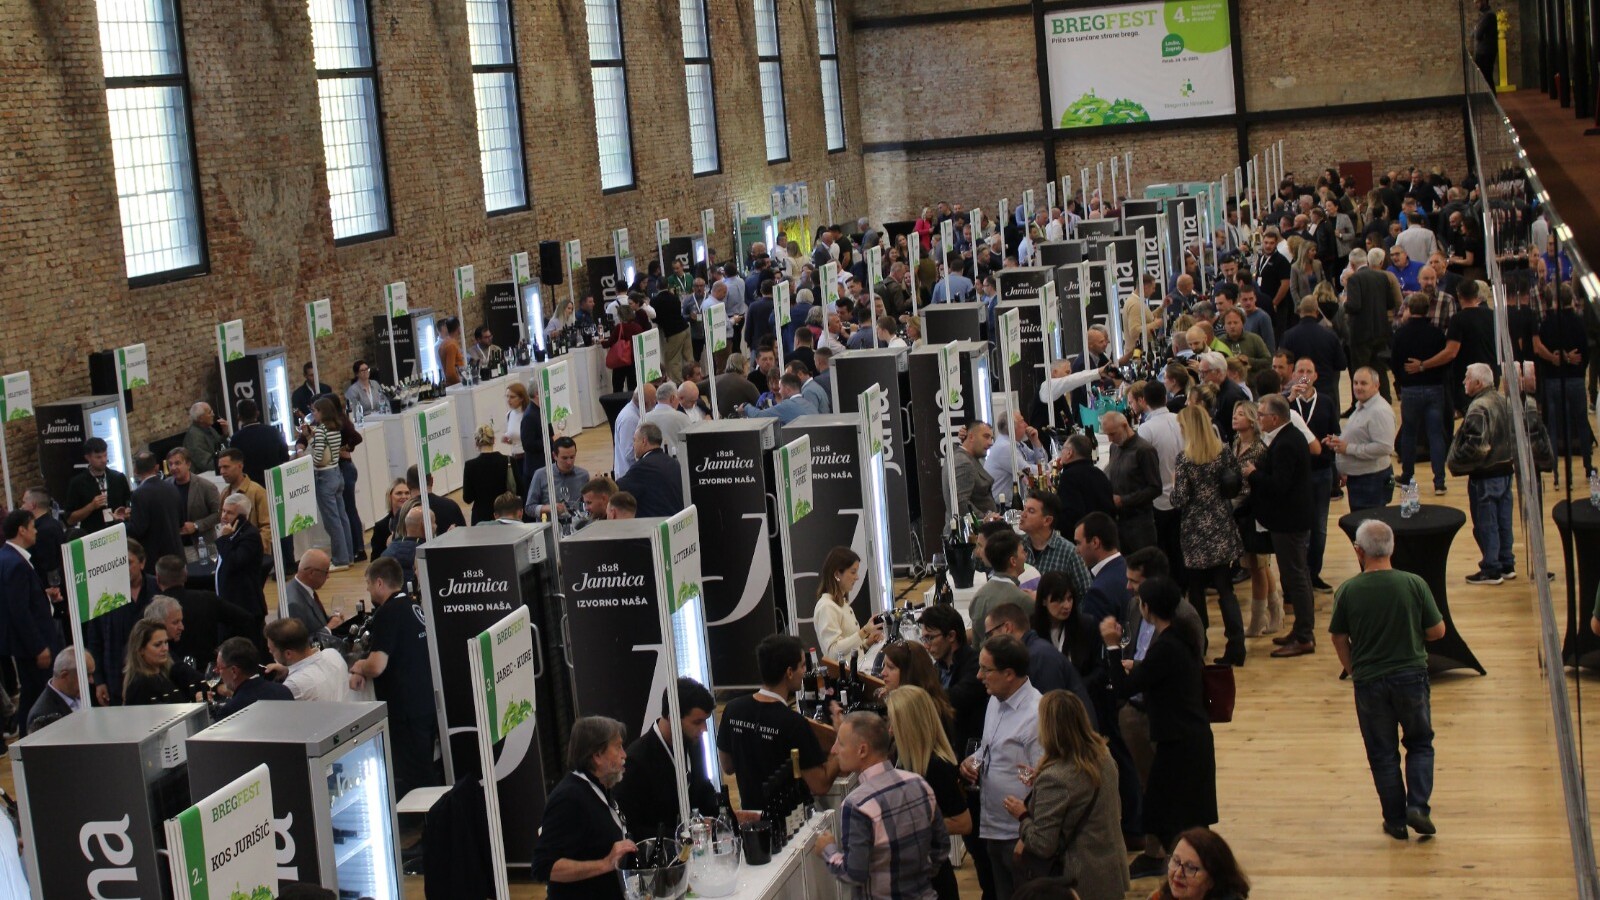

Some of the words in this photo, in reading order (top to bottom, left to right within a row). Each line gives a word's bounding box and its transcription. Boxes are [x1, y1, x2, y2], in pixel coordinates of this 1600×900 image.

[1051, 10, 1157, 34] BREGFEST
[1174, 6, 1190, 23] 4.
[42, 423, 80, 435] Jamnica
[716, 449, 734, 457] 1828
[812, 444, 830, 453] 1828
[695, 456, 754, 473] Jamnica
[698, 476, 733, 485] IZVORNO
[734, 474, 756, 484] NAŠA
[830, 470, 853, 479] NAŠA
[89, 531, 121, 551] BREGFEST
[88, 555, 127, 579] TOPOLOVČAN
[462, 569, 484, 579] 1828
[596, 563, 619, 573] 1828
[75, 571, 87, 584] 27.
[571, 572, 645, 592] Jamnica
[438, 577, 510, 597] Jamnica
[443, 603, 484, 613] IZVORNO
[486, 601, 512, 611] NAŠA
[576, 598, 619, 608] IZVORNO
[621, 596, 648, 606] NAŠA
[496, 617, 525, 646] BREGFEST
[486, 677, 493, 692] 3.
[211, 780, 261, 823] BREGFEST
[211, 847, 232, 872] KOS
[233, 818, 271, 859] JURIŠIĆ
[192, 867, 204, 887] 2.
